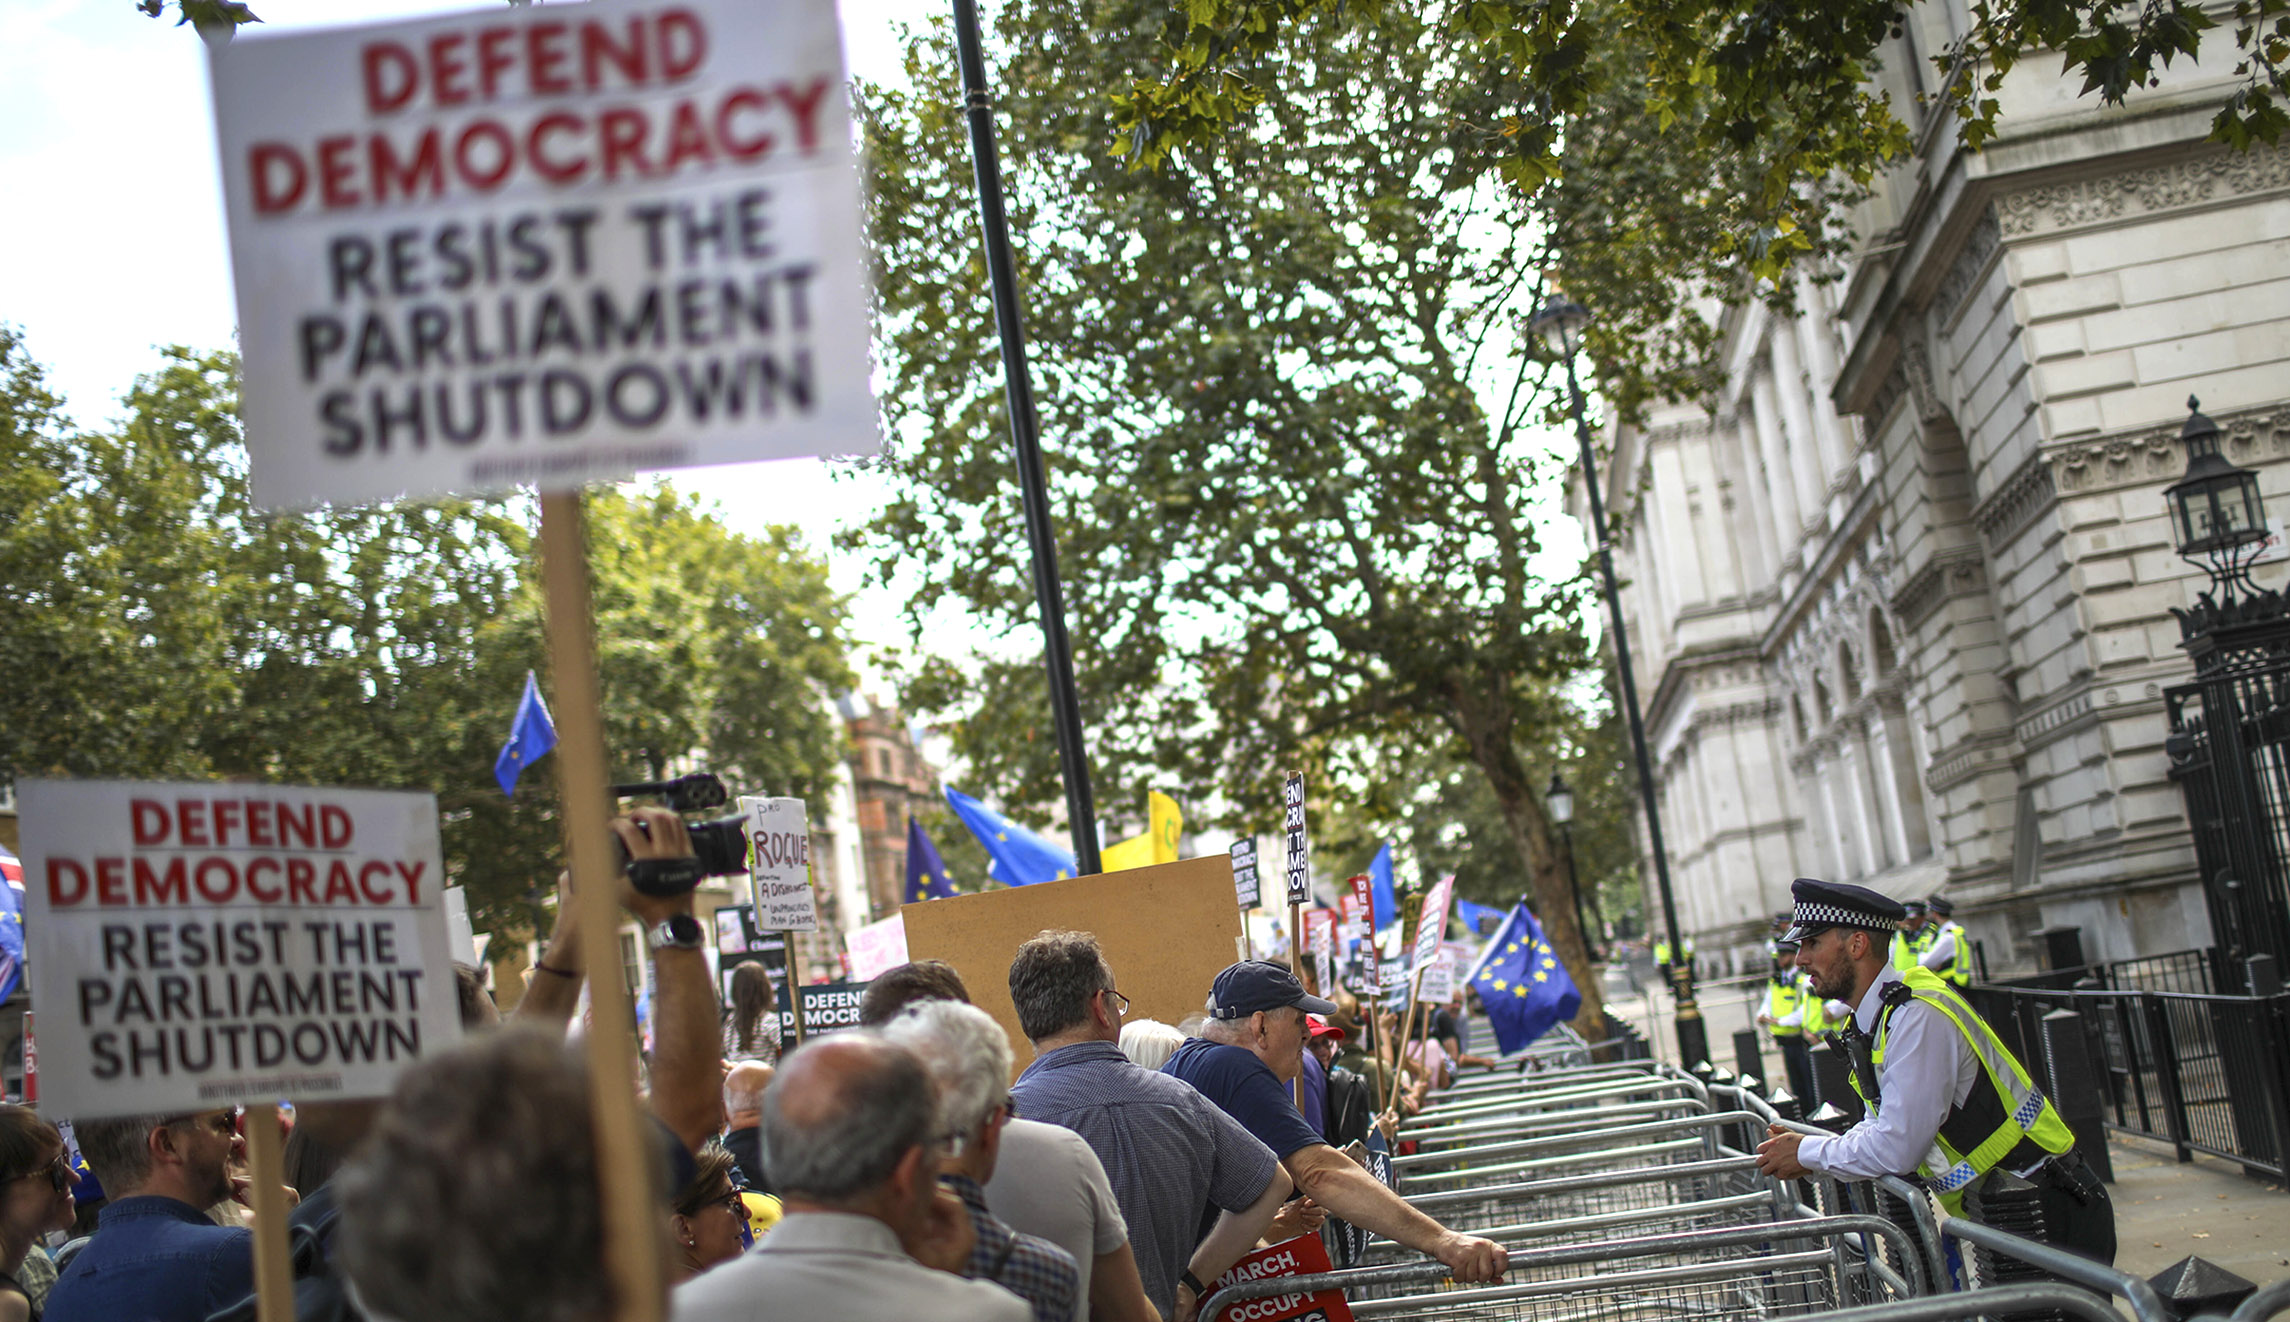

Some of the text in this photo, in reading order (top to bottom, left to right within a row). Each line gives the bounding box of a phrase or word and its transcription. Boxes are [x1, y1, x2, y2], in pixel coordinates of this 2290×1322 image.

[362, 8, 711, 118] DEFEND
[248, 76, 834, 216] DEMOCRACY
[328, 188, 775, 302] RESIST THE
[298, 265, 815, 386] PARLIAMENT
[317, 350, 817, 459] SHUTDOWN
[130, 798, 354, 849] DEFEND
[753, 831, 808, 868] ROGUE
[45, 857, 427, 907] DEMOCRACY
[762, 882, 769, 898] A
[103, 921, 396, 971] RESIST THE
[78, 970, 423, 1026] PARLIAMENT
[91, 1018, 421, 1081] SHUTDOWN
[1216, 1250, 1300, 1288] MARCH,
[1229, 1291, 1315, 1322] OCCUPY
